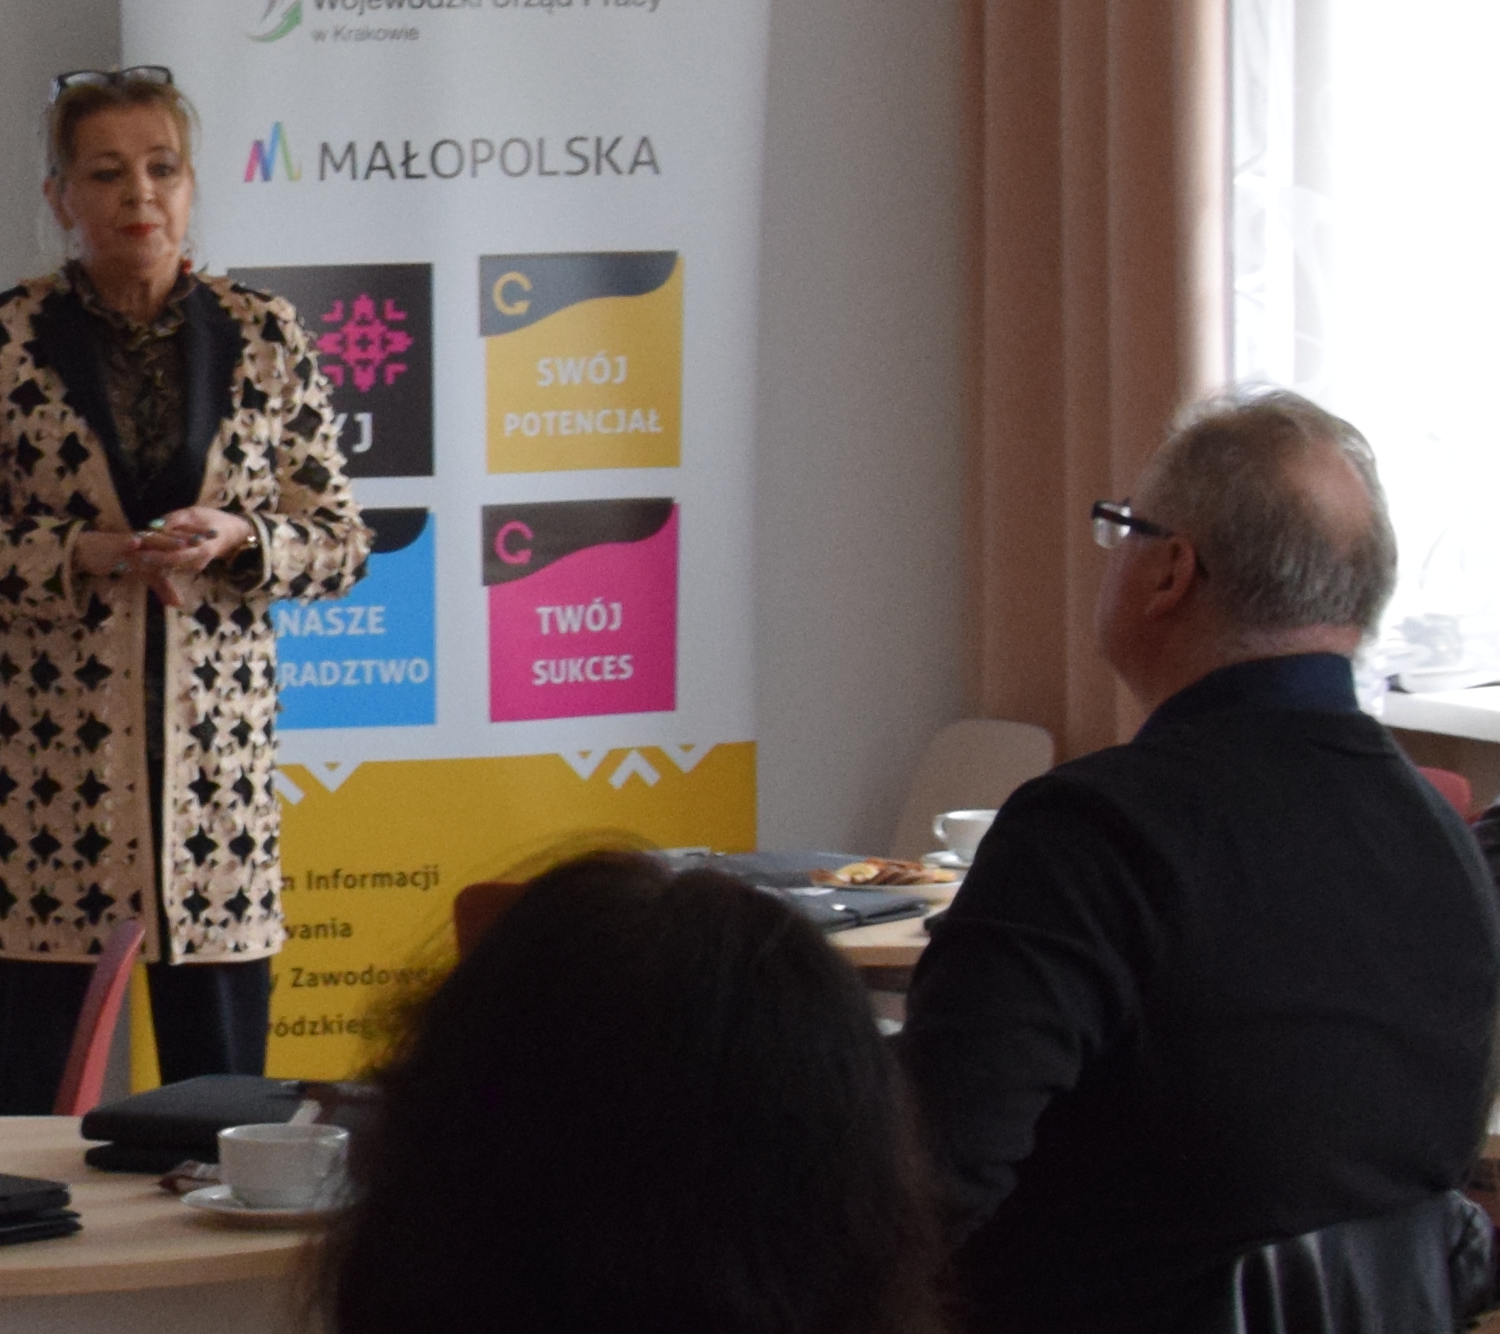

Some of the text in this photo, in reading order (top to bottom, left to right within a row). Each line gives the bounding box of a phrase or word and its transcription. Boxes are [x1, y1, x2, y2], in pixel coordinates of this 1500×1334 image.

[311, 25, 420, 42] w Krakowie
[317, 135, 660, 182] MAŁOPOLSKA
[537, 350, 628, 388] SWÓJ
[504, 408, 663, 438] POTENCJAŁ
[276, 606, 386, 637] NASZE
[535, 597, 623, 636] TWÓJ
[277, 658, 430, 688] RADZTWO
[532, 654, 634, 687] SUKCES
[306, 863, 440, 892] Informacji
